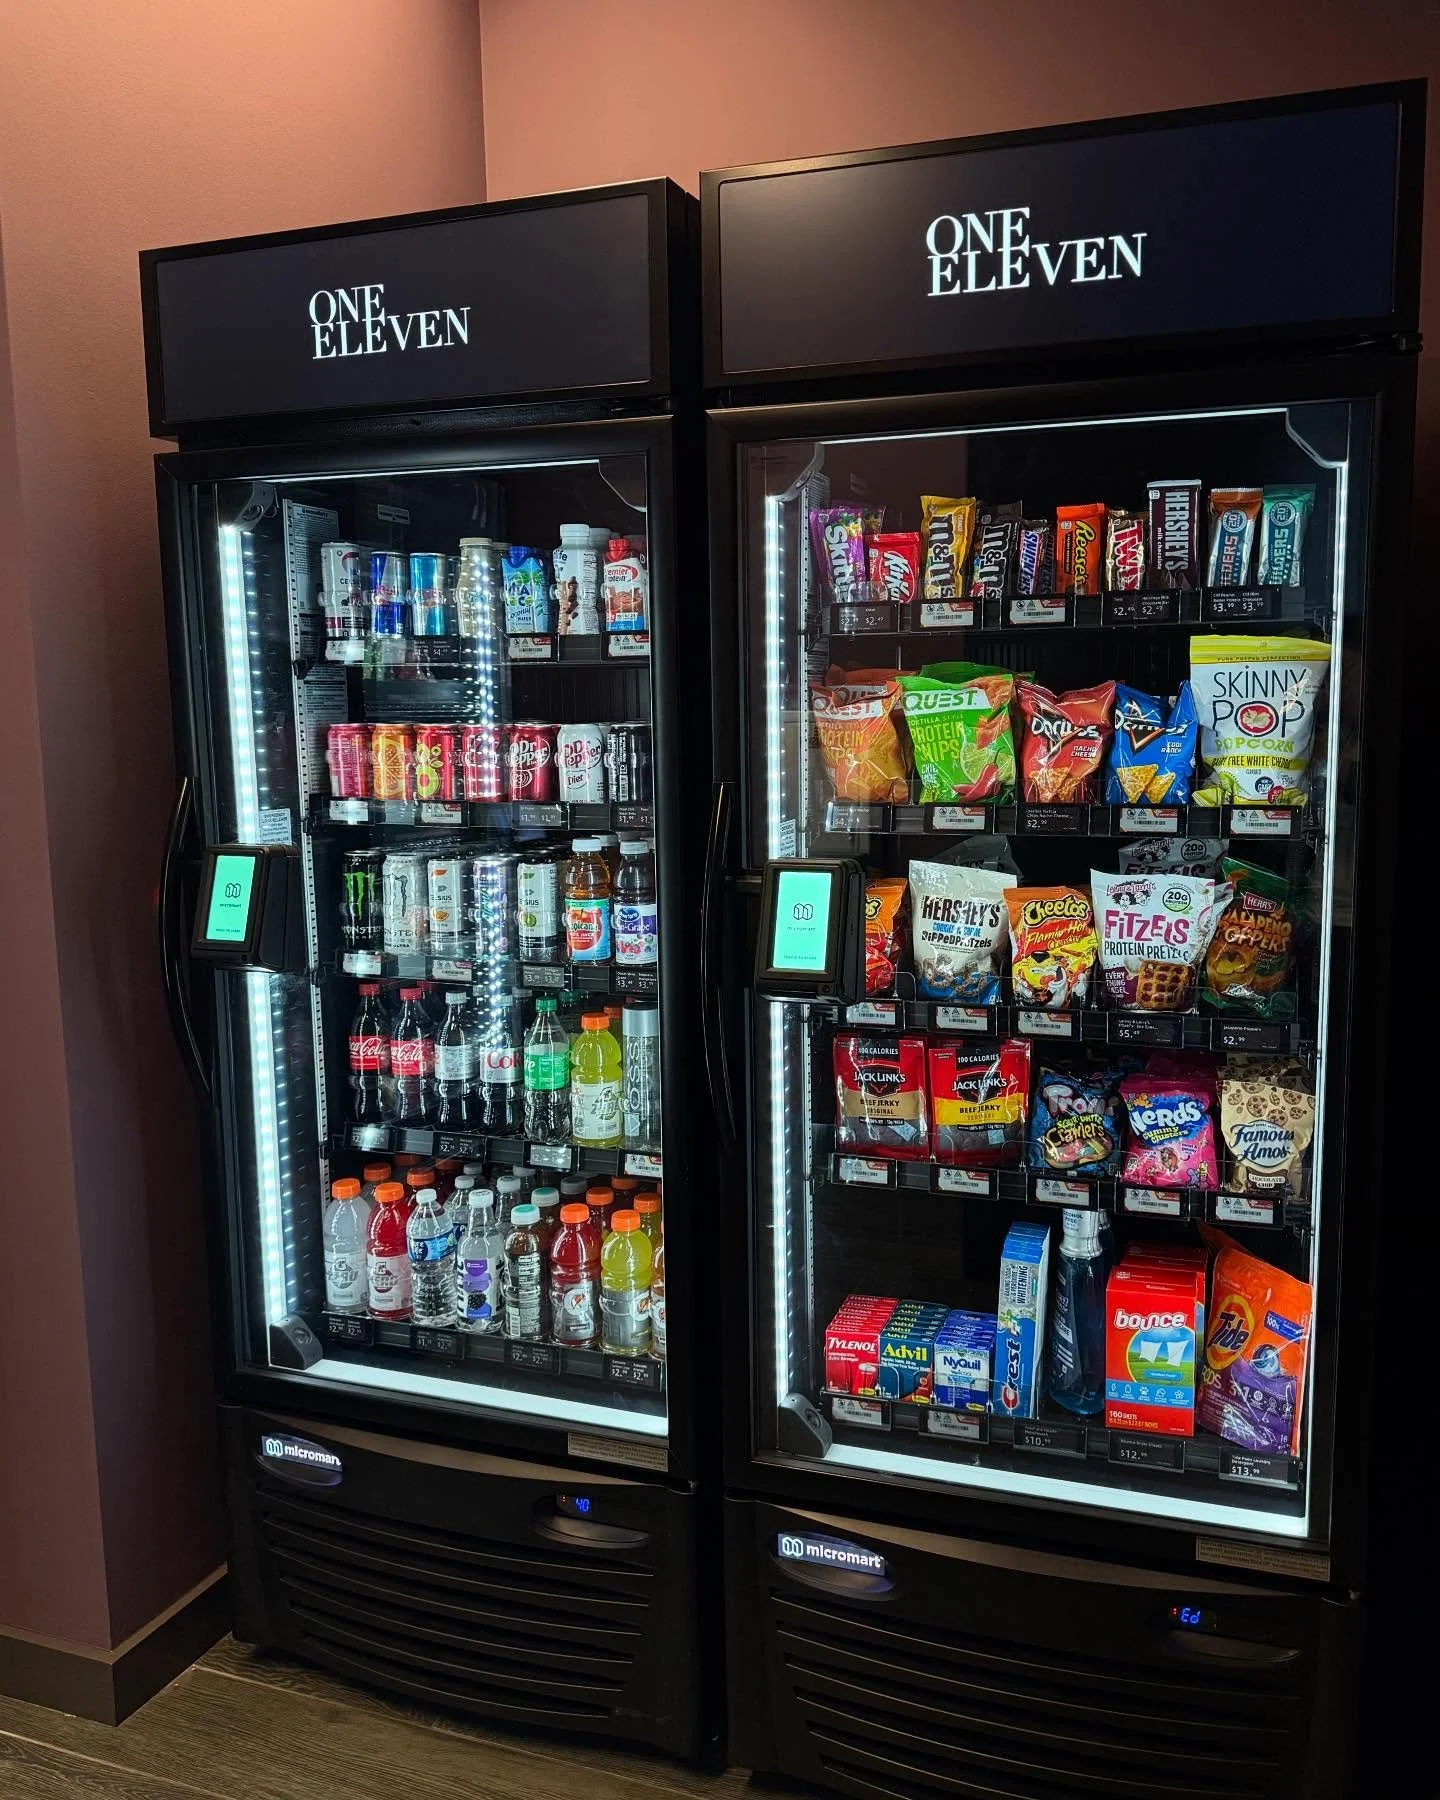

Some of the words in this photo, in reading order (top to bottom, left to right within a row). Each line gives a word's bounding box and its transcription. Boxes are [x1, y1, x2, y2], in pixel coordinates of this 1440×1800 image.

[926, 207, 1030, 259] ONE
[926, 233, 1147, 297] ELEVEN
[308, 283, 385, 327] ONE
[311, 306, 472, 360] ELEVEN
[1164, 491, 1190, 571] HERSHEY'S
[903, 689, 978, 713] QUEST
[1212, 699, 1306, 740] POP
[1214, 737, 1295, 753] POPCORN
[1247, 755, 1270, 766] WHITE
[1023, 896, 1090, 926] Cheetos
[1104, 941, 1144, 958] PROTEIN
[1229, 1124, 1295, 1149] Famous
[1237, 1142, 1293, 1162] Amos
[1016, 1265, 1028, 1304] WHITENING
[1114, 1309, 1188, 1332] bounce
[1208, 1312, 1249, 1351] Tide
[828, 1337, 877, 1354] TYLENOL
[882, 1344, 928, 1366] Advil
[943, 1356, 981, 1376] NyQuil
[575, 1498, 590, 1512] 40
[806, 1544, 885, 1570] micromart
